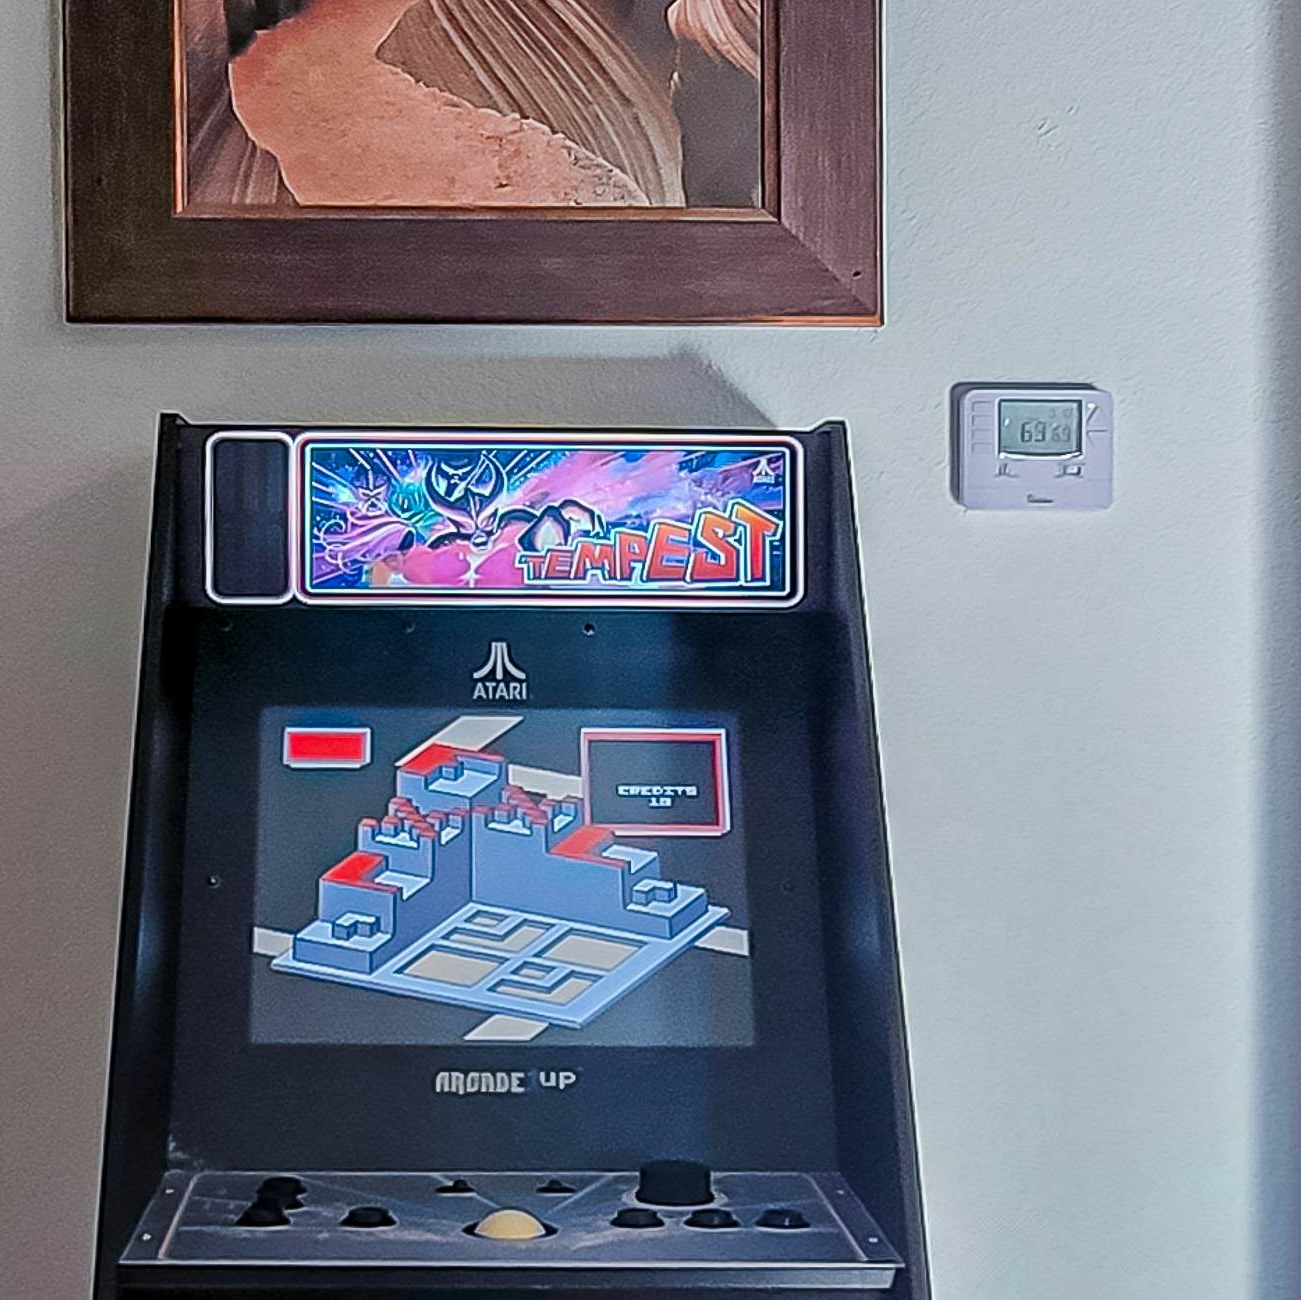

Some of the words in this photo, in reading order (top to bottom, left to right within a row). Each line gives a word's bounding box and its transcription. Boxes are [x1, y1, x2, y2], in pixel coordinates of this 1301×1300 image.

[515, 498, 784, 587] TEMPEST
[472, 681, 528, 700] ATARI
[617, 785, 698, 796] CREDITS
